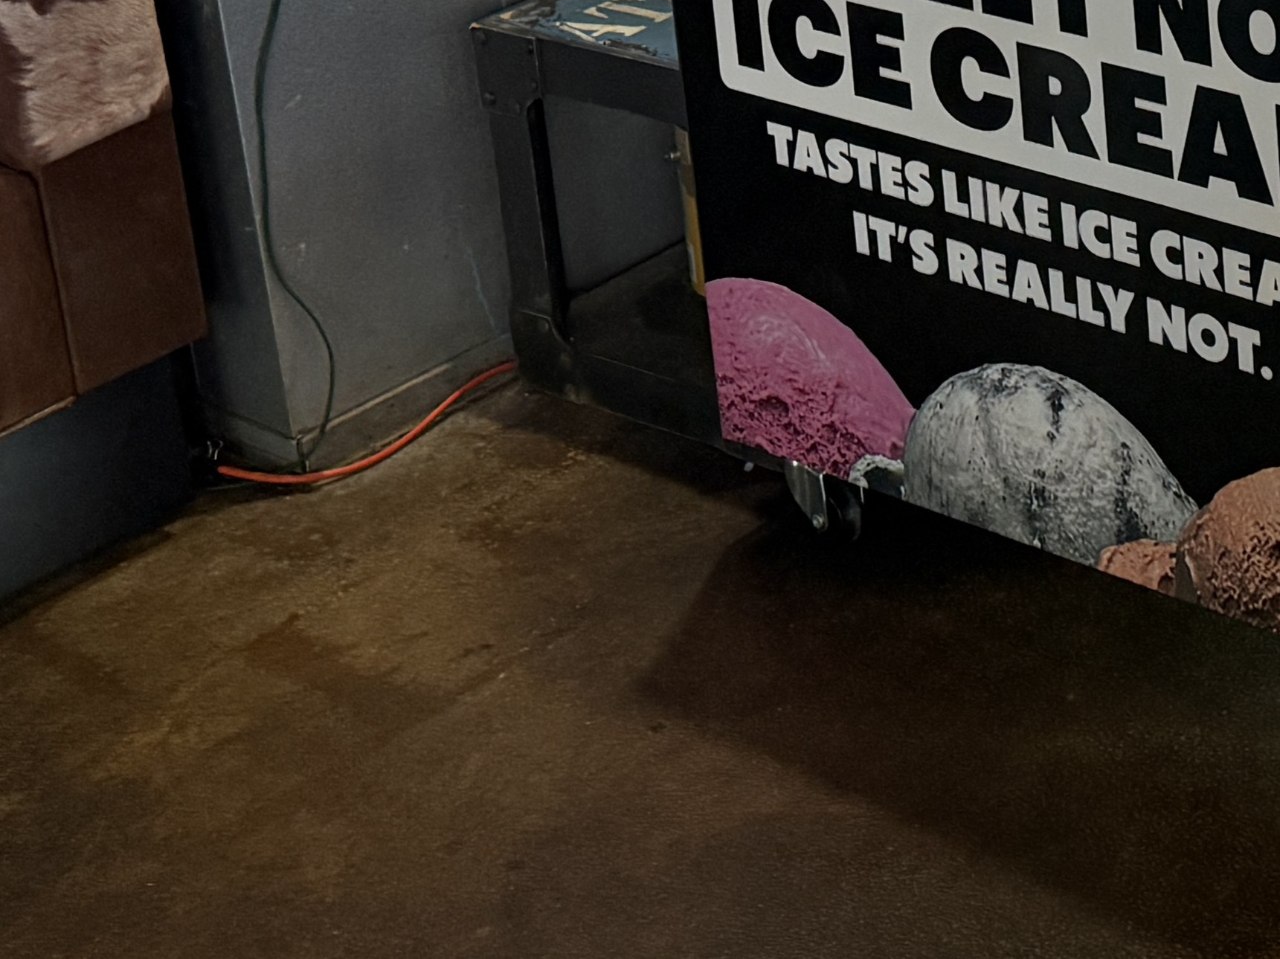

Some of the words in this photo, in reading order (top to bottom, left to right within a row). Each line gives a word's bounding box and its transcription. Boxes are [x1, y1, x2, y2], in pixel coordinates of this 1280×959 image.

[766, 120, 934, 207] TASTES
[941, 168, 1052, 242] LIKE
[1060, 201, 1141, 268] ICE
[852, 210, 939, 276] IT'S
[946, 238, 1135, 335] REALLY
[1146, 296, 1273, 381] NOT.
